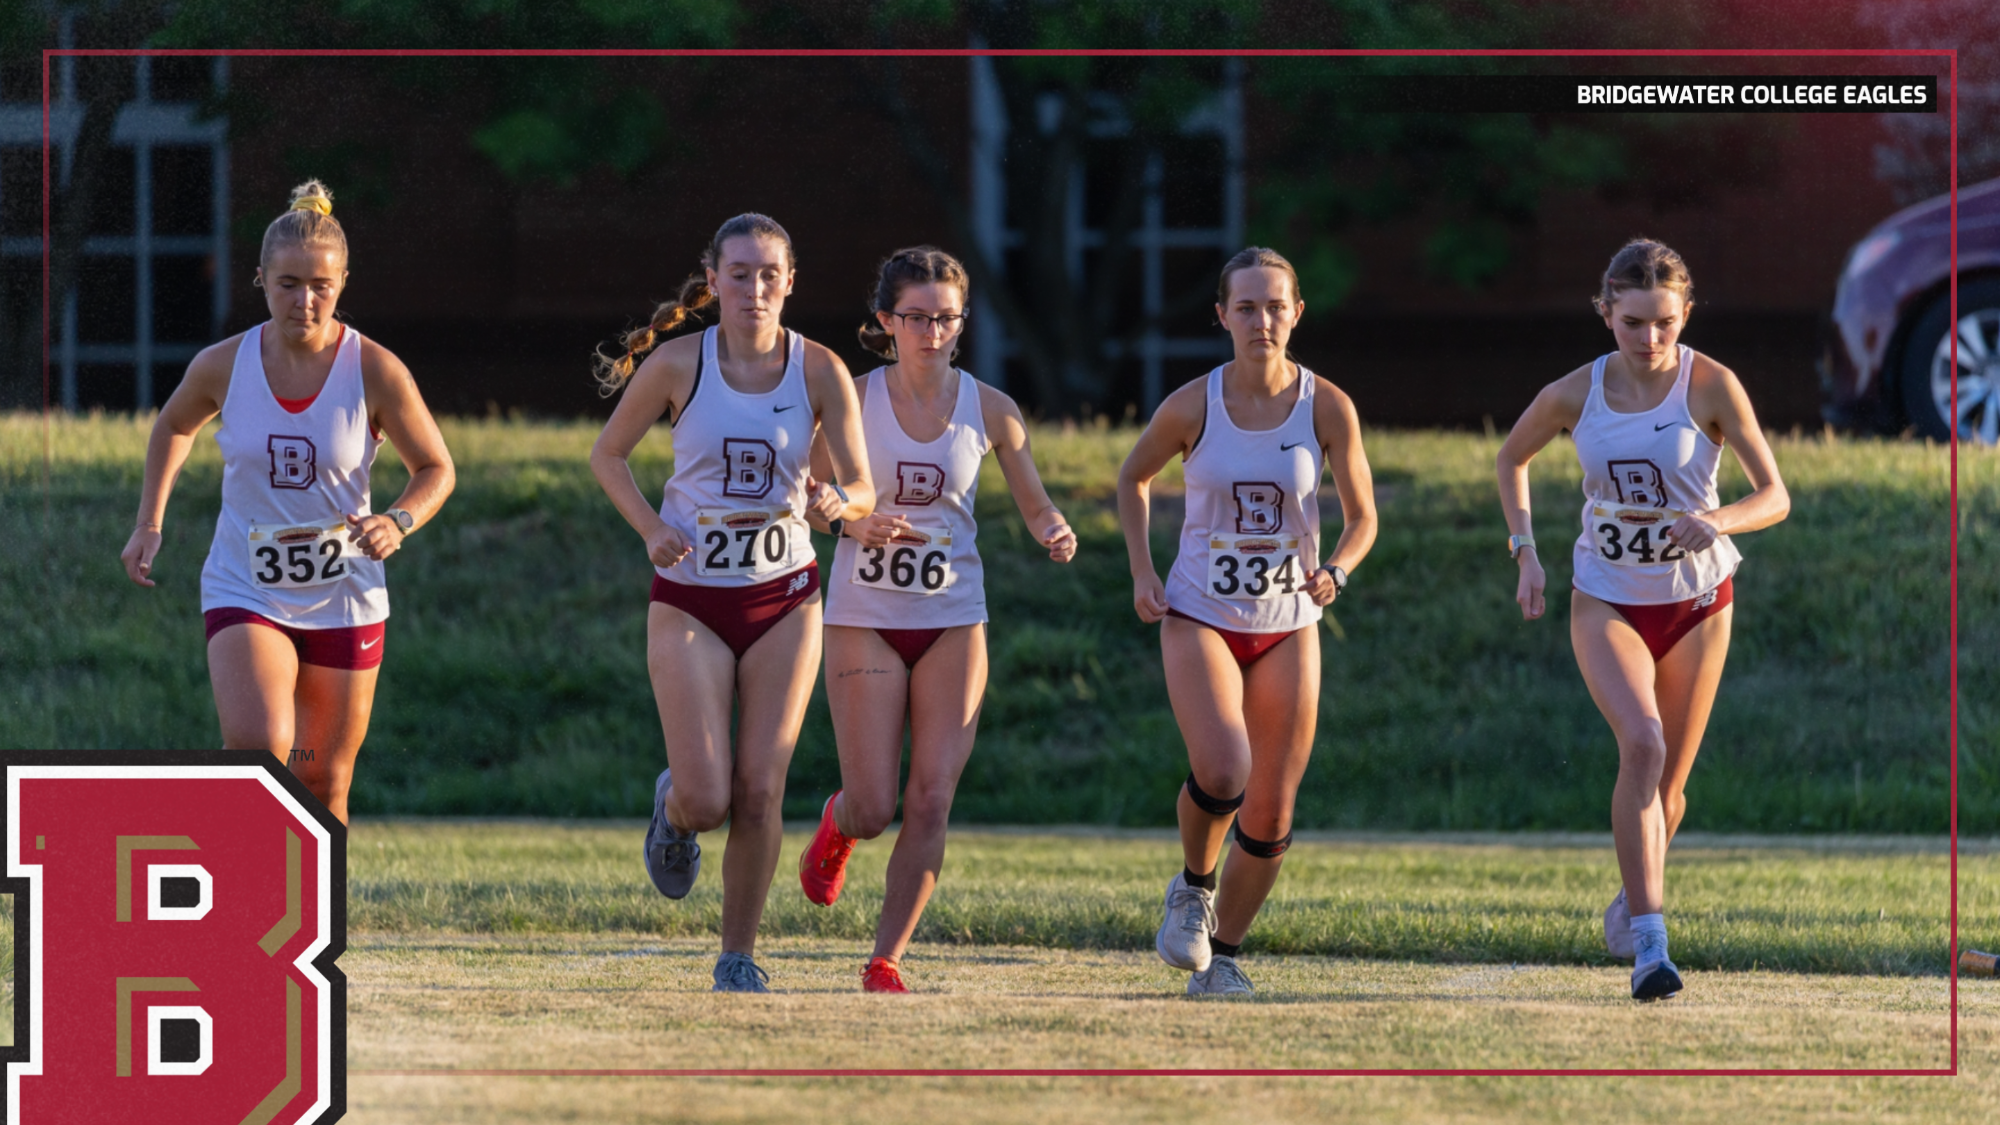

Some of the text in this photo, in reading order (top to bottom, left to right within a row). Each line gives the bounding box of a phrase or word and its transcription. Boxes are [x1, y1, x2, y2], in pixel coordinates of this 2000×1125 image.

[267, 434, 317, 490] B
[722, 437, 776, 499] B
[894, 461, 945, 506] B
[1607, 458, 1668, 508] B
[1232, 481, 1285, 534] B
[255, 539, 345, 584] 352
[704, 523, 787, 569] 270
[1597, 523, 1686, 563] 342
[858, 546, 947, 590] 366
[1212, 554, 1296, 596] 334
